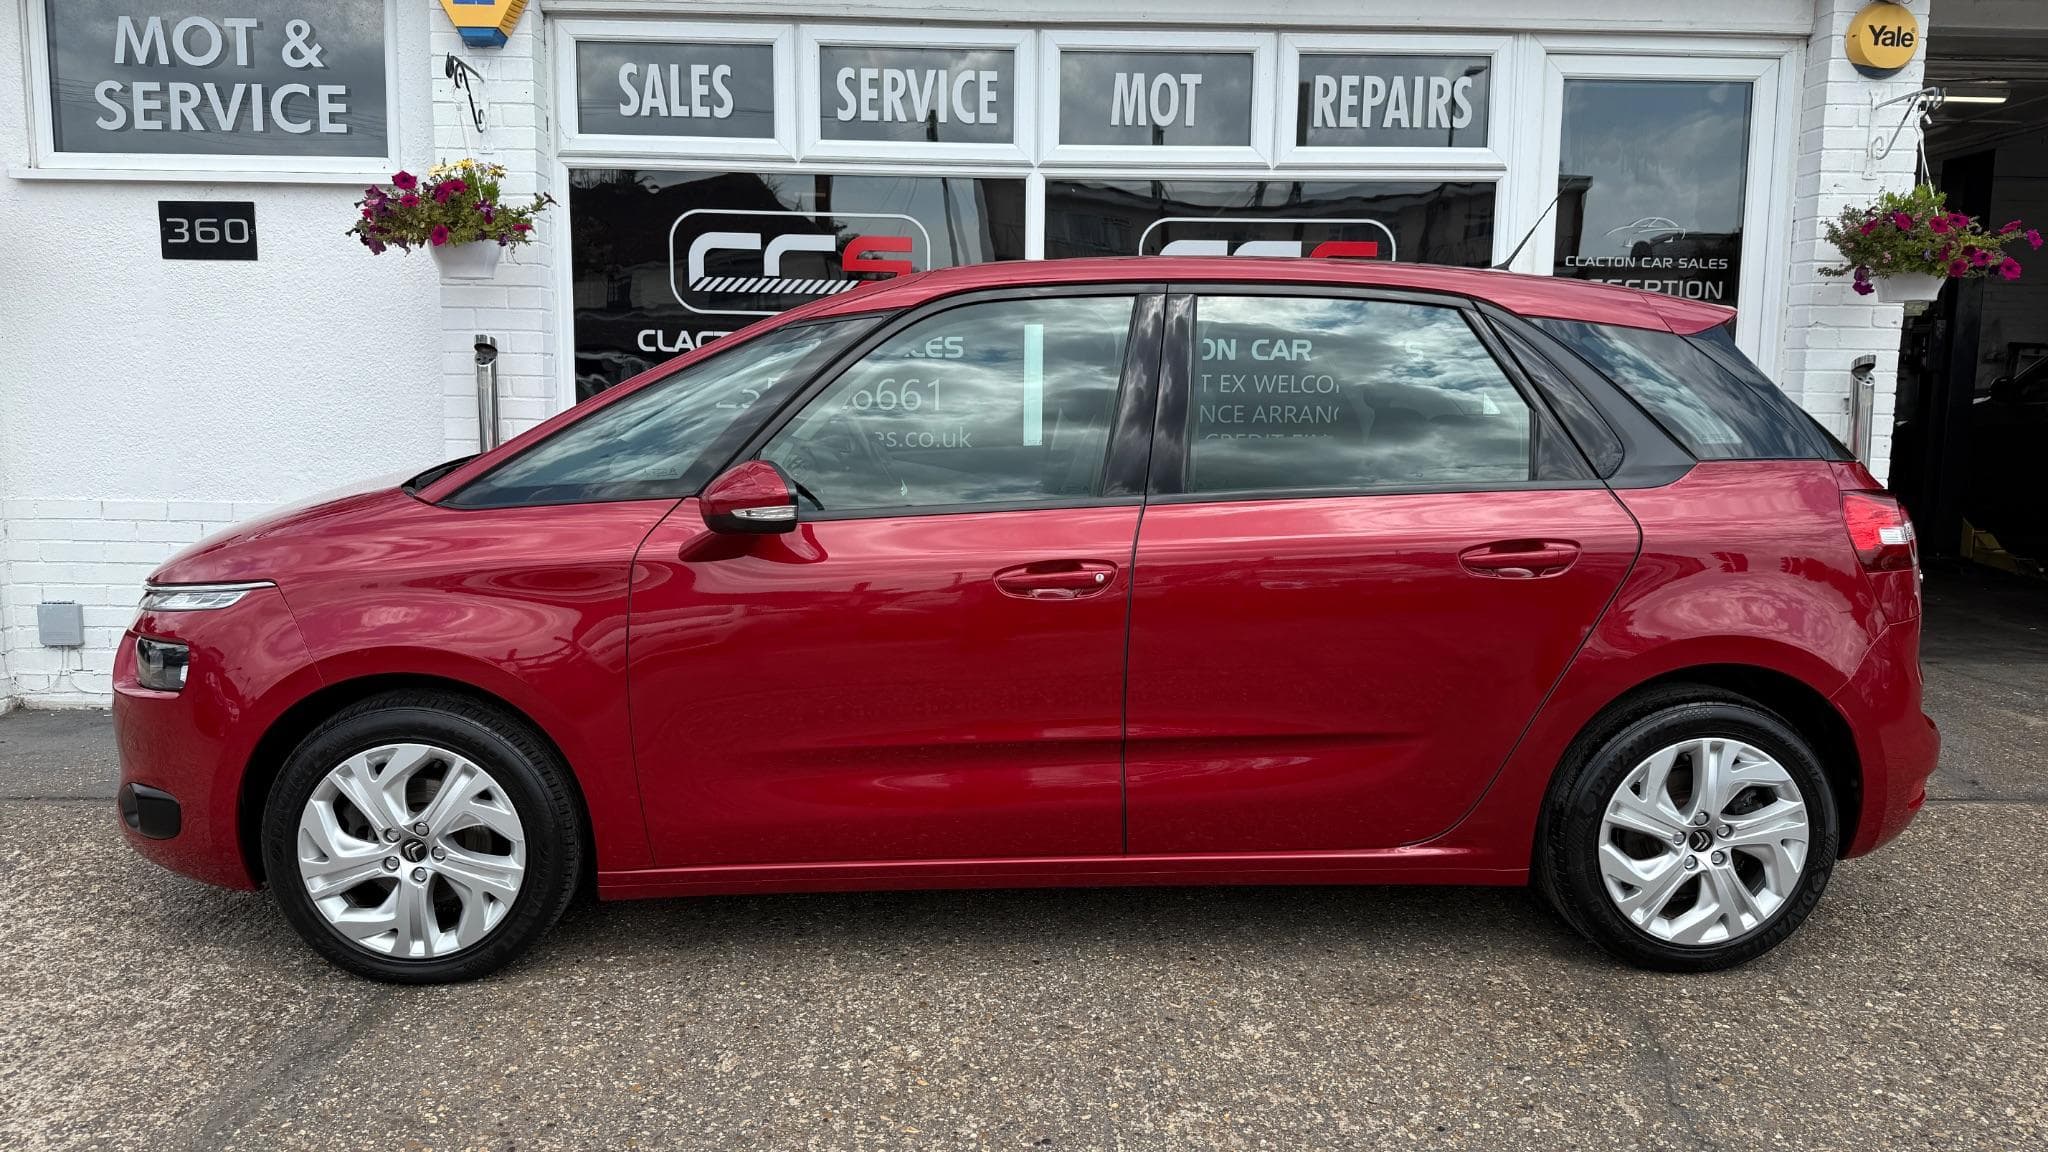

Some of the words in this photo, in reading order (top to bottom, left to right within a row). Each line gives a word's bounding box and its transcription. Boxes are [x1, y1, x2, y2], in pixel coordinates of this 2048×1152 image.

[114, 15, 260, 68] MOT
[282, 18, 326, 69] &
[1868, 25, 1915, 48] Yale
[95, 80, 350, 134] SERVICE
[618, 63, 734, 119] SALES
[836, 67, 998, 125] SERVICE
[1110, 72, 1202, 128] MOT
[1313, 75, 1473, 129] REPAIRS
[166, 217, 250, 244] 360
[1565, 255, 1636, 268] CLACTON
[1641, 257, 1673, 269] CAR
[1678, 258, 1729, 270] SALES
[1251, 338, 1313, 361] CAR
[1220, 374, 1246, 393] EX
[1253, 374, 1340, 394] WELCO
